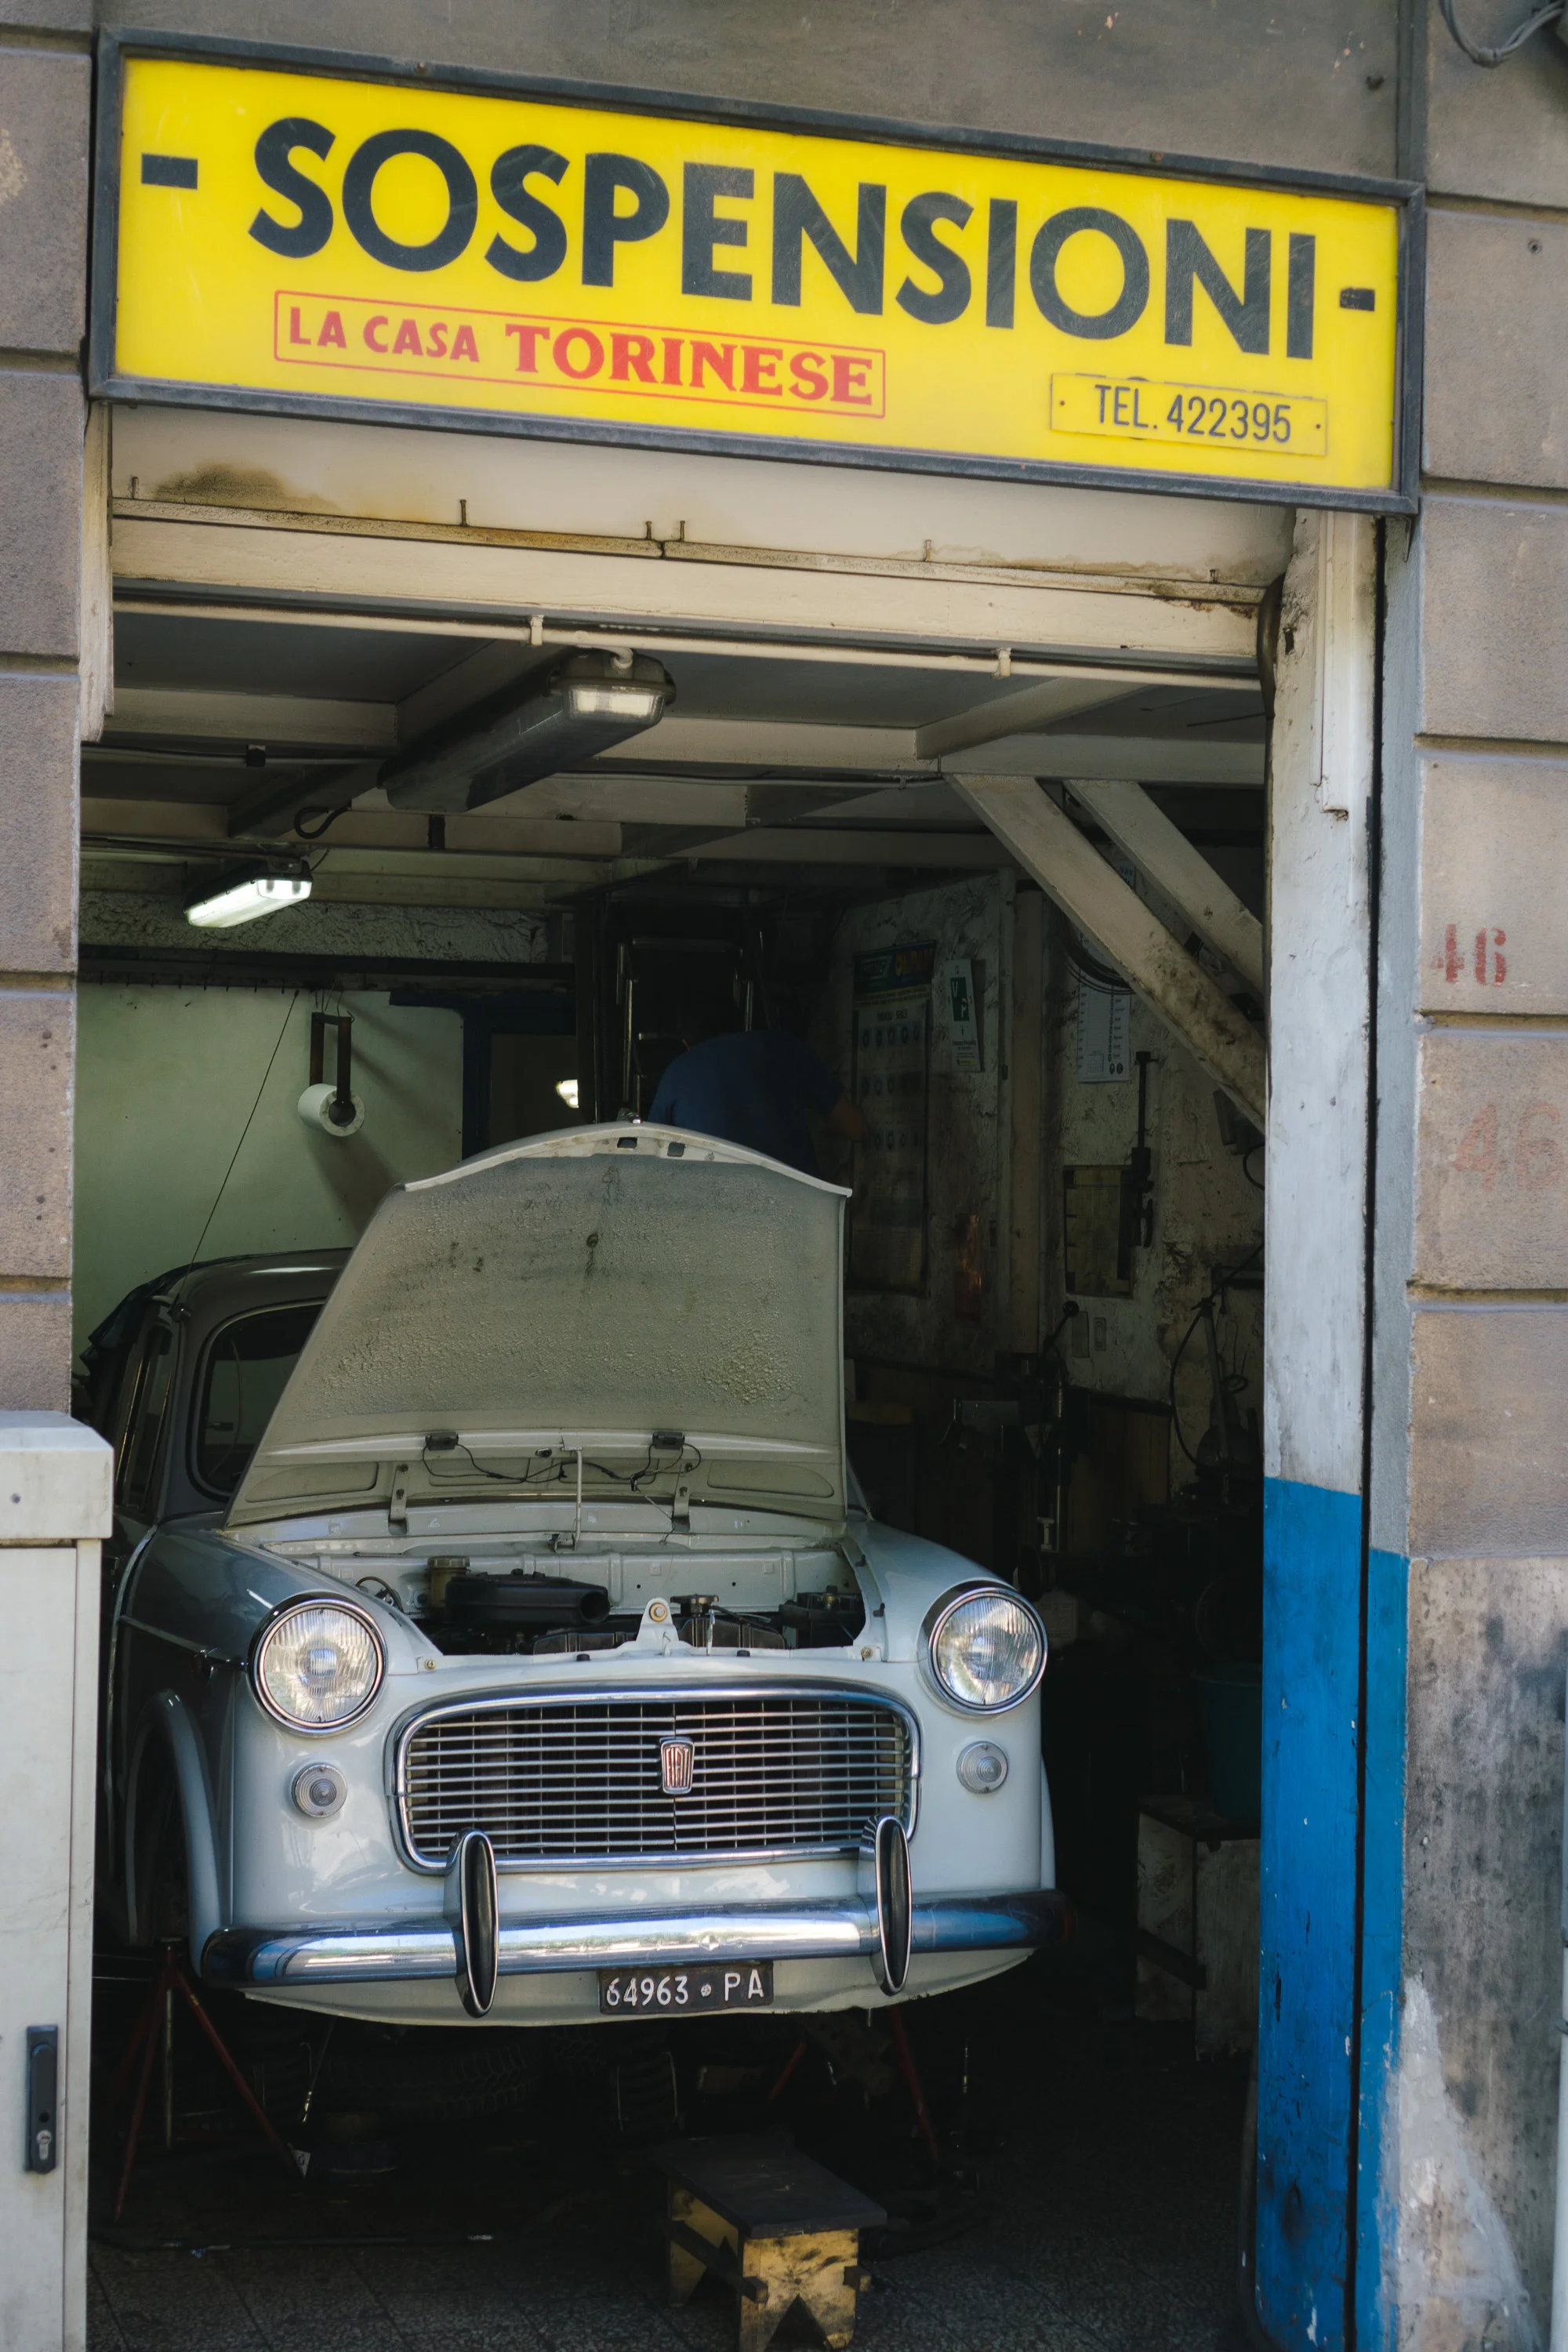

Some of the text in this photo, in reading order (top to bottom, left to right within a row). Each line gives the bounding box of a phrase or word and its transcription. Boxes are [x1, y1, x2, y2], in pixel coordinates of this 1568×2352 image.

[248, 117, 1316, 360] SOSPENSIONI
[289, 306, 873, 406] LA CASA TORINESE
[1094, 383, 1292, 444] TEL. 422395
[666, 1748, 689, 1788] FIAT
[606, 1969, 764, 2007] 64963 PA
